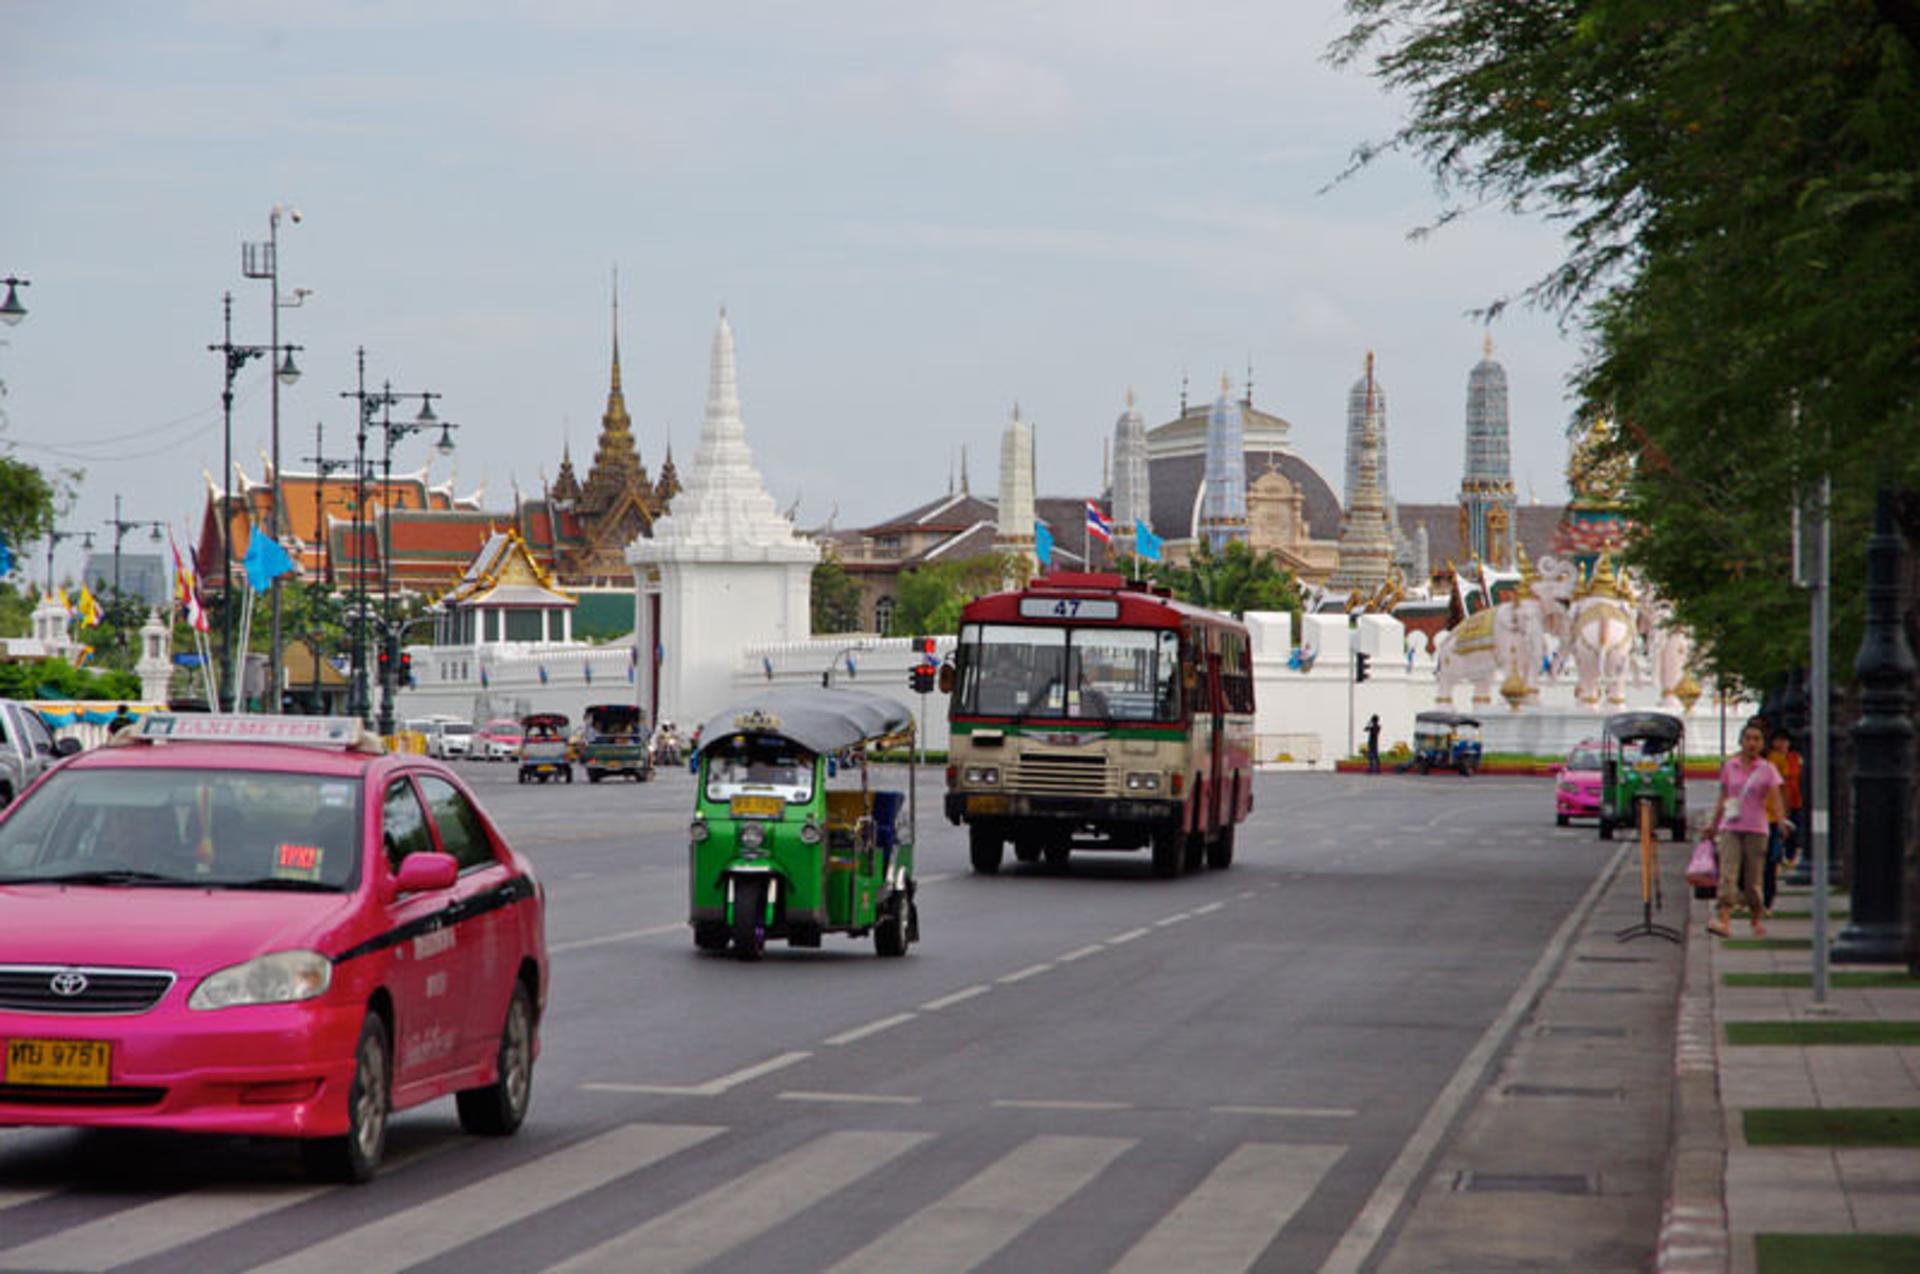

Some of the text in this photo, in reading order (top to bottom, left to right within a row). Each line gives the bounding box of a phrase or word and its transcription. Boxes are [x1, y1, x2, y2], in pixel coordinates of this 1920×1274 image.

[1054, 599, 1081, 616] 47
[235, 719, 321, 737] METER
[52, 1044, 105, 1068] 9751
